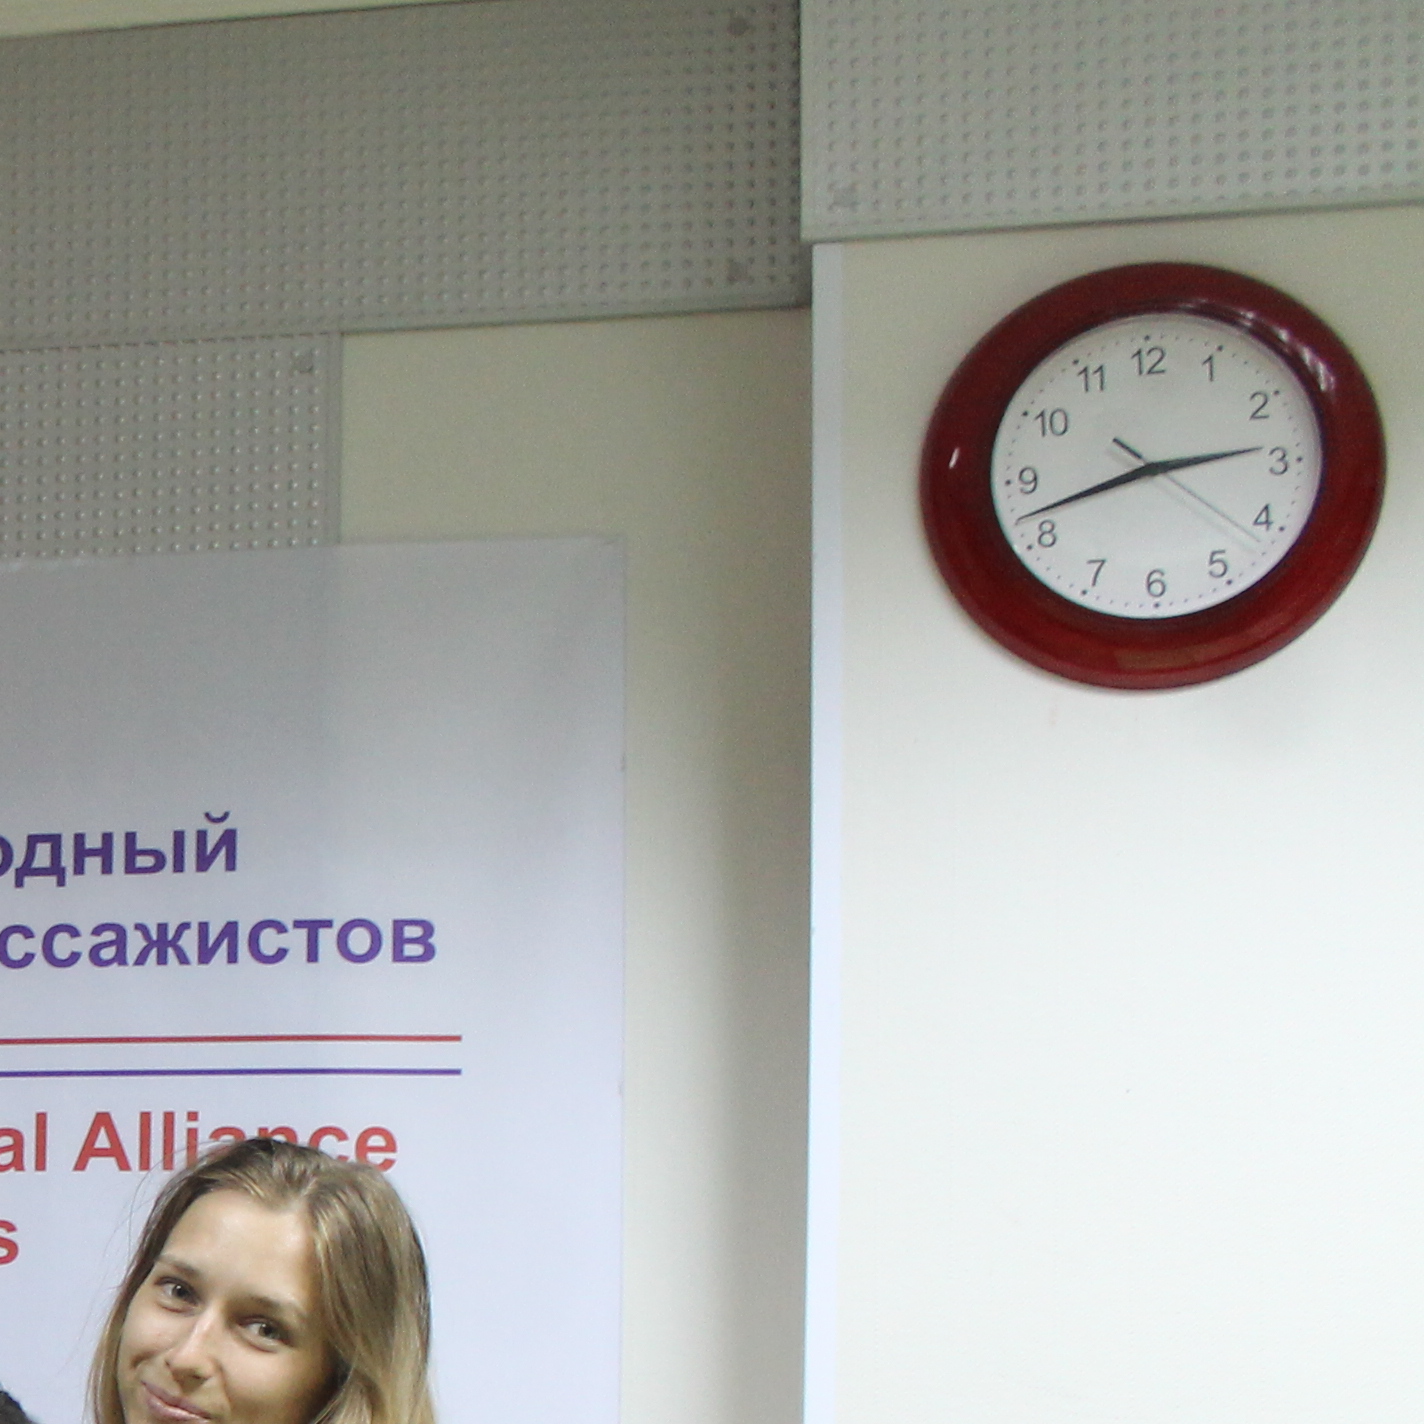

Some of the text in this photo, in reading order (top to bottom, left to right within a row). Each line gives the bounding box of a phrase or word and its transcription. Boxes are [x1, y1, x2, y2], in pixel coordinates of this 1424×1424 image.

[1130, 347, 1166, 375] 12
[1202, 355, 1215, 381] 1
[1077, 365, 1107, 392] 11
[1249, 391, 1271, 420] 2
[1034, 408, 1069, 437] 10
[1268, 446, 1289, 476] 3
[1018, 466, 1038, 494] 9
[1252, 503, 1273, 530] 4
[1037, 519, 1057, 548] 8
[1087, 559, 1106, 587] 7
[1208, 550, 1228, 578] 5
[1145, 570, 1166, 598] 6
